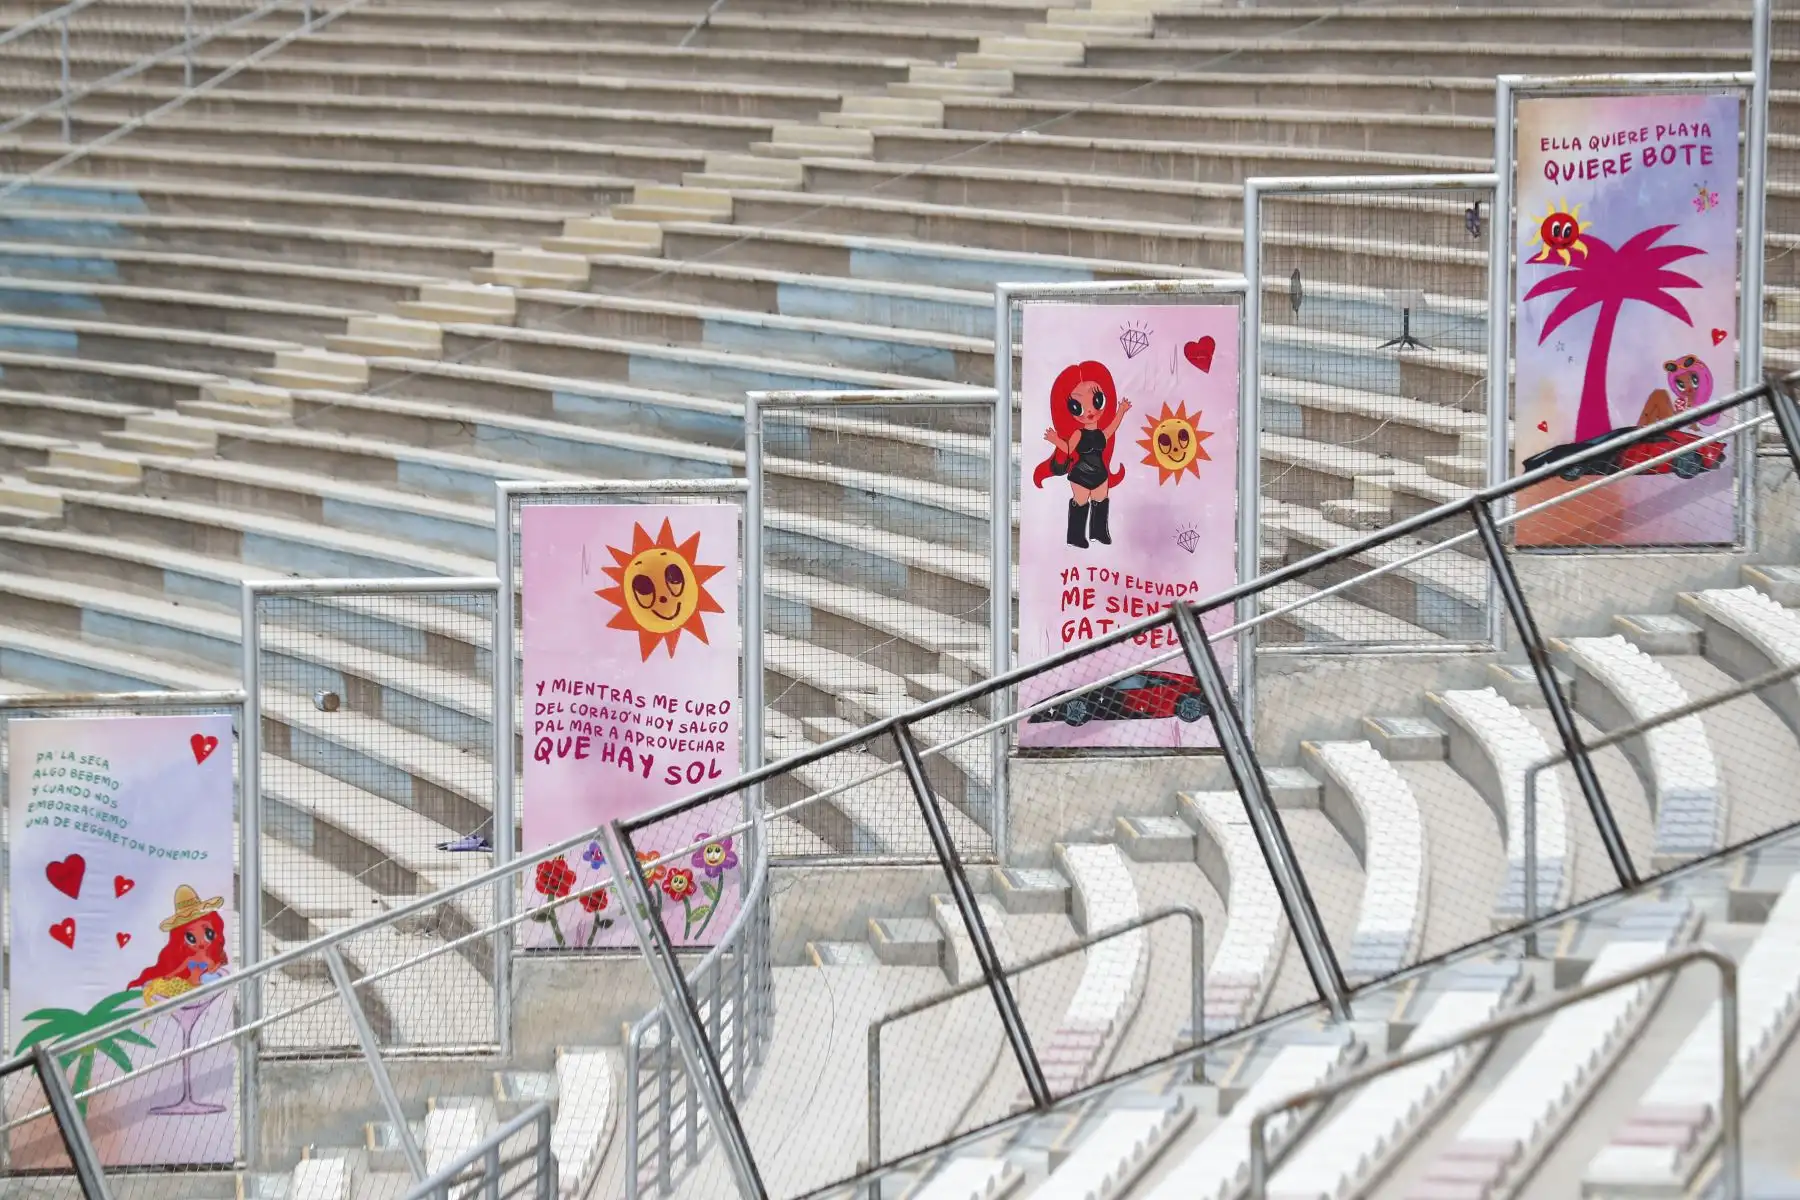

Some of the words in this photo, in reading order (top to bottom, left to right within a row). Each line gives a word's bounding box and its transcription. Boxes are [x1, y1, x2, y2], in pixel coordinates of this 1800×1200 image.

[1541, 137, 1582, 152] ELLA
[1588, 127, 1648, 152] QUIERE
[1656, 122, 1712, 141] PLAYA
[1544, 152, 1632, 184] QUIERE
[1642, 144, 1714, 168] BOTE
[1060, 566, 1080, 585] YA
[1086, 567, 1120, 585] TOY
[1126, 576, 1199, 597] ELEVADA
[1062, 586, 1096, 611] ME
[536, 680, 545, 696] Y
[552, 678, 646, 708] MIENTRAS
[652, 694, 678, 713] ME
[685, 700, 730, 716] CURO
[536, 702, 564, 716] DEL
[646, 716, 674, 732] HOY
[679, 721, 728, 734] SALGO
[535, 720, 564, 735] PAL
[570, 720, 603, 736] MAR
[609, 726, 618, 740] A
[624, 730, 725, 753] APROVECHAR
[33, 768, 66, 779] ALGO
[60, 751, 76, 761] LA
[80, 755, 109, 770] SECA
[534, 736, 590, 764] QUE
[602, 742, 654, 779] HAY
[664, 758, 722, 785] SOL
[32, 785, 39, 796] Y
[42, 784, 90, 798] CUANDO
[94, 792, 118, 808] NOS
[26, 816, 48, 828] UNA
[54, 816, 72, 828] DE
[75, 820, 144, 852] REGGAETON
[148, 845, 208, 860] PONEMOS
